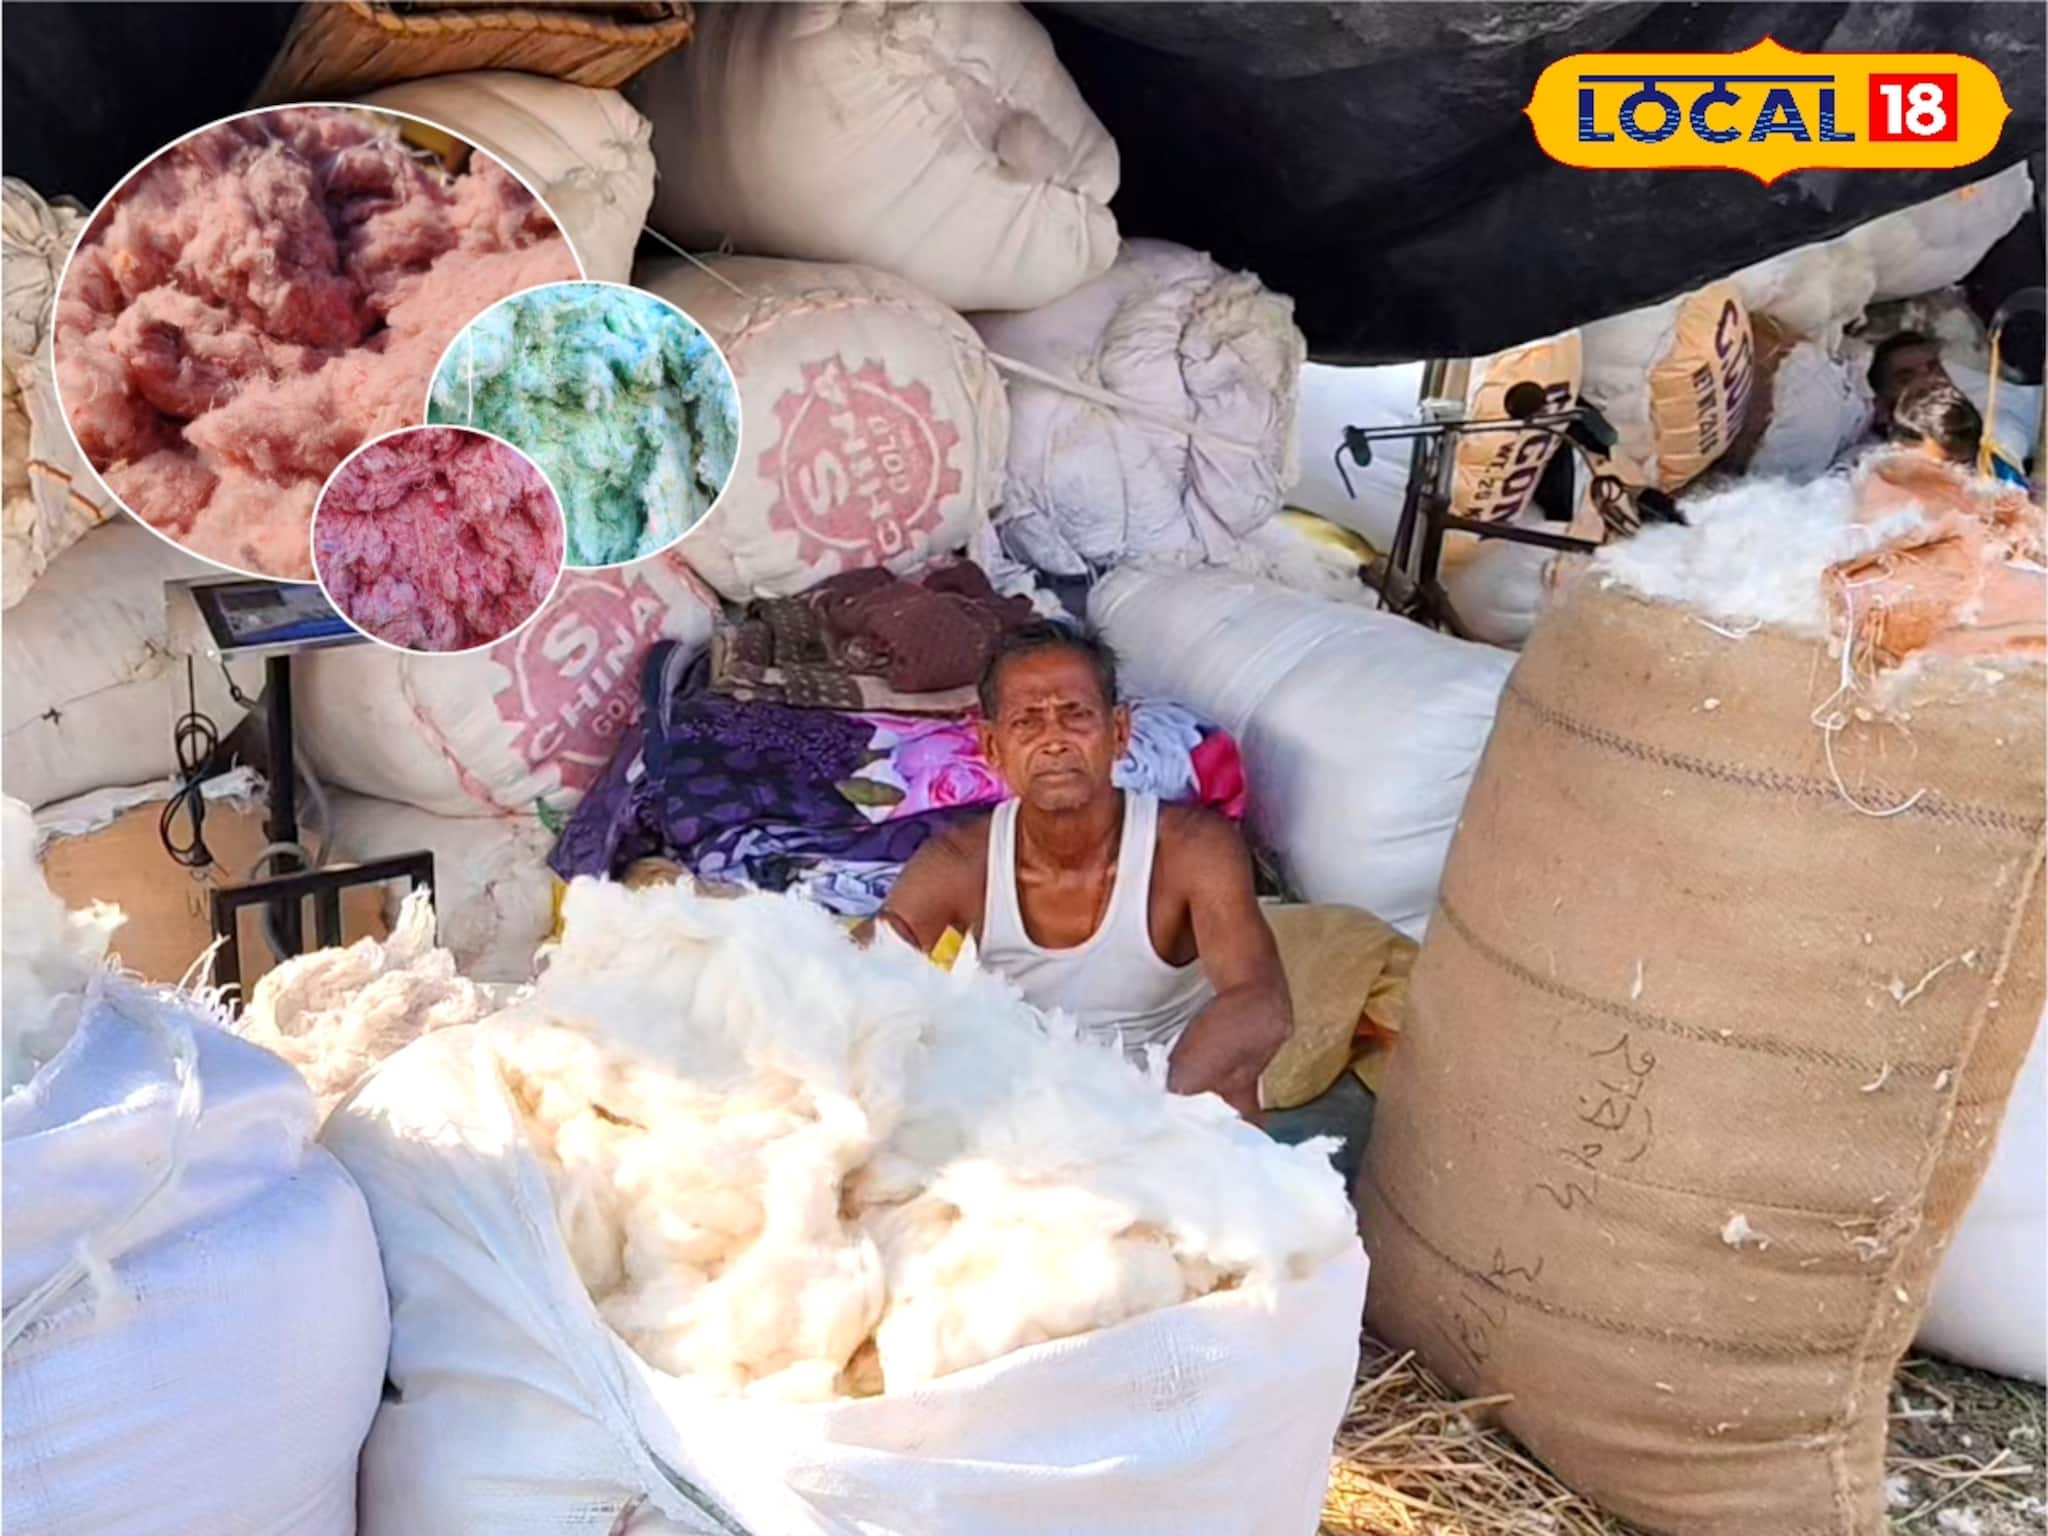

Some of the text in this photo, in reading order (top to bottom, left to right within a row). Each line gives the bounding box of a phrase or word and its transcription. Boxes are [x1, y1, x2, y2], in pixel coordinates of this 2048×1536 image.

[798, 450, 850, 516] S
[528, 596, 662, 760] CHINA
[542, 612, 599, 678] S
